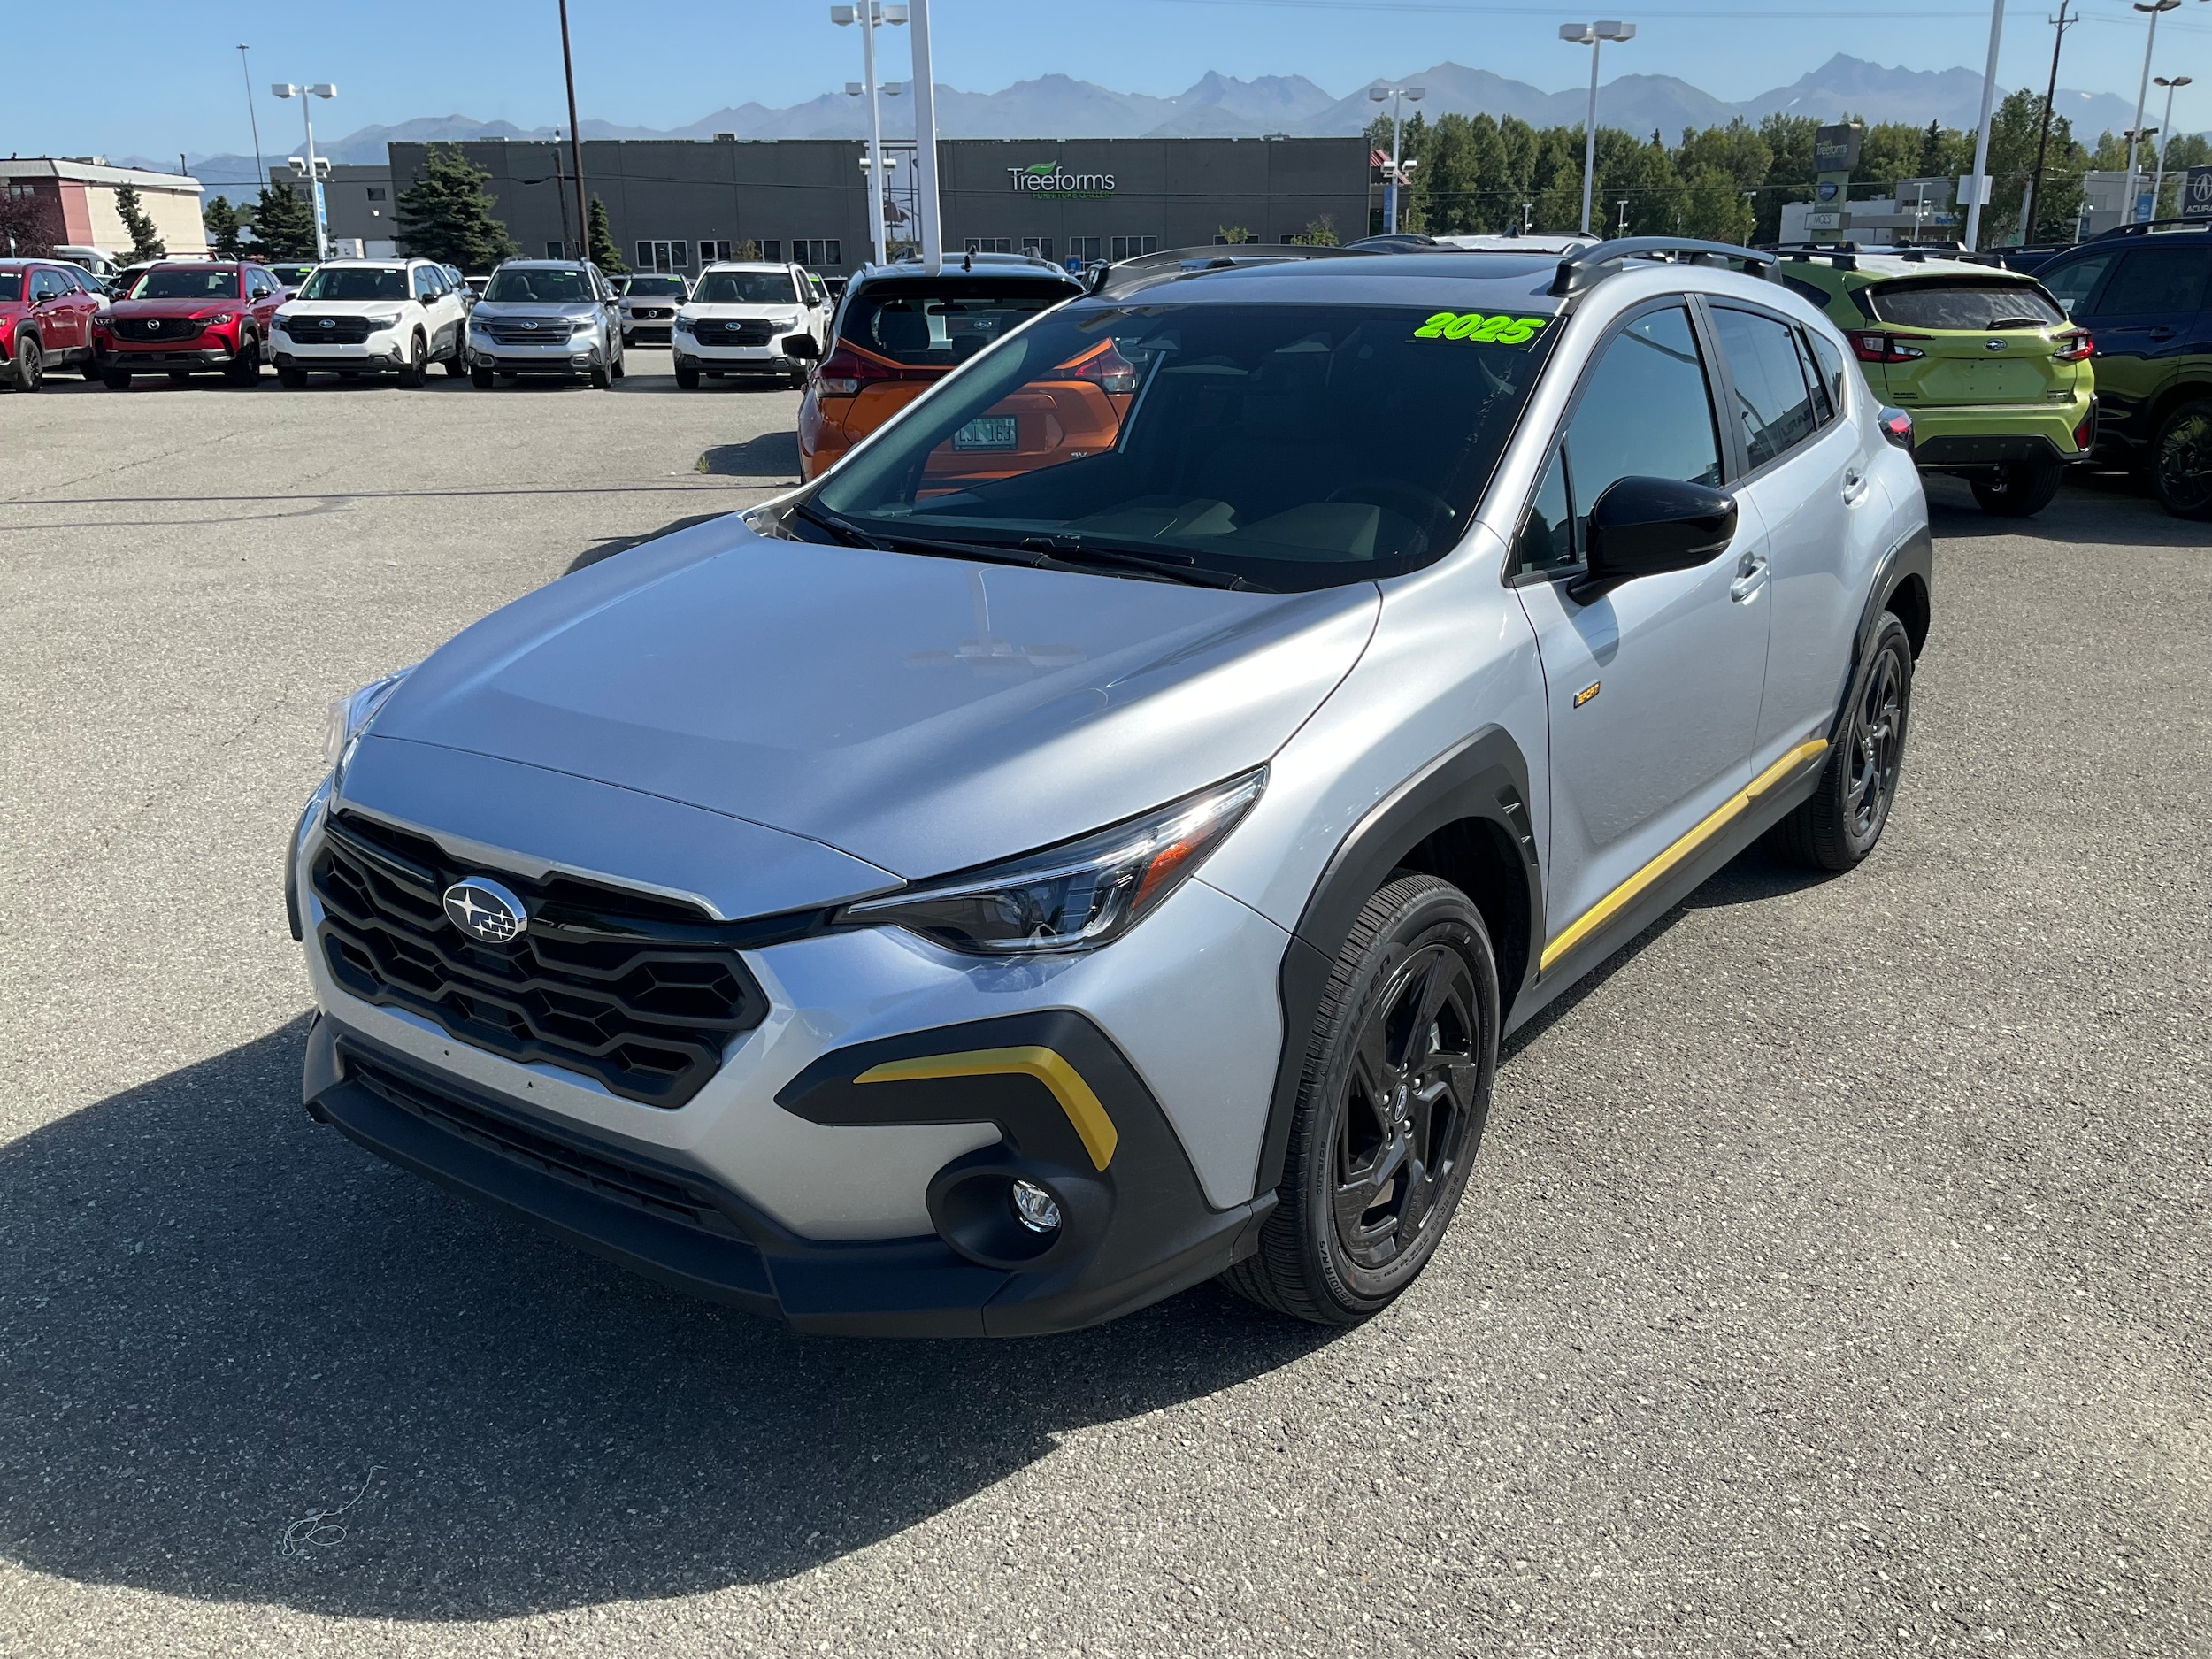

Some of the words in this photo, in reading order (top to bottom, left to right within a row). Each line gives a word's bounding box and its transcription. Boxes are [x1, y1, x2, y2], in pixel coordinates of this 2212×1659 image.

[1816, 141, 1848, 156] Treeforms
[1007, 165, 1116, 191] Treeforms
[1079, 190, 1115, 199] GALLERY
[1413, 311, 1547, 344] 2025
[989, 425, 1010, 442] 163
